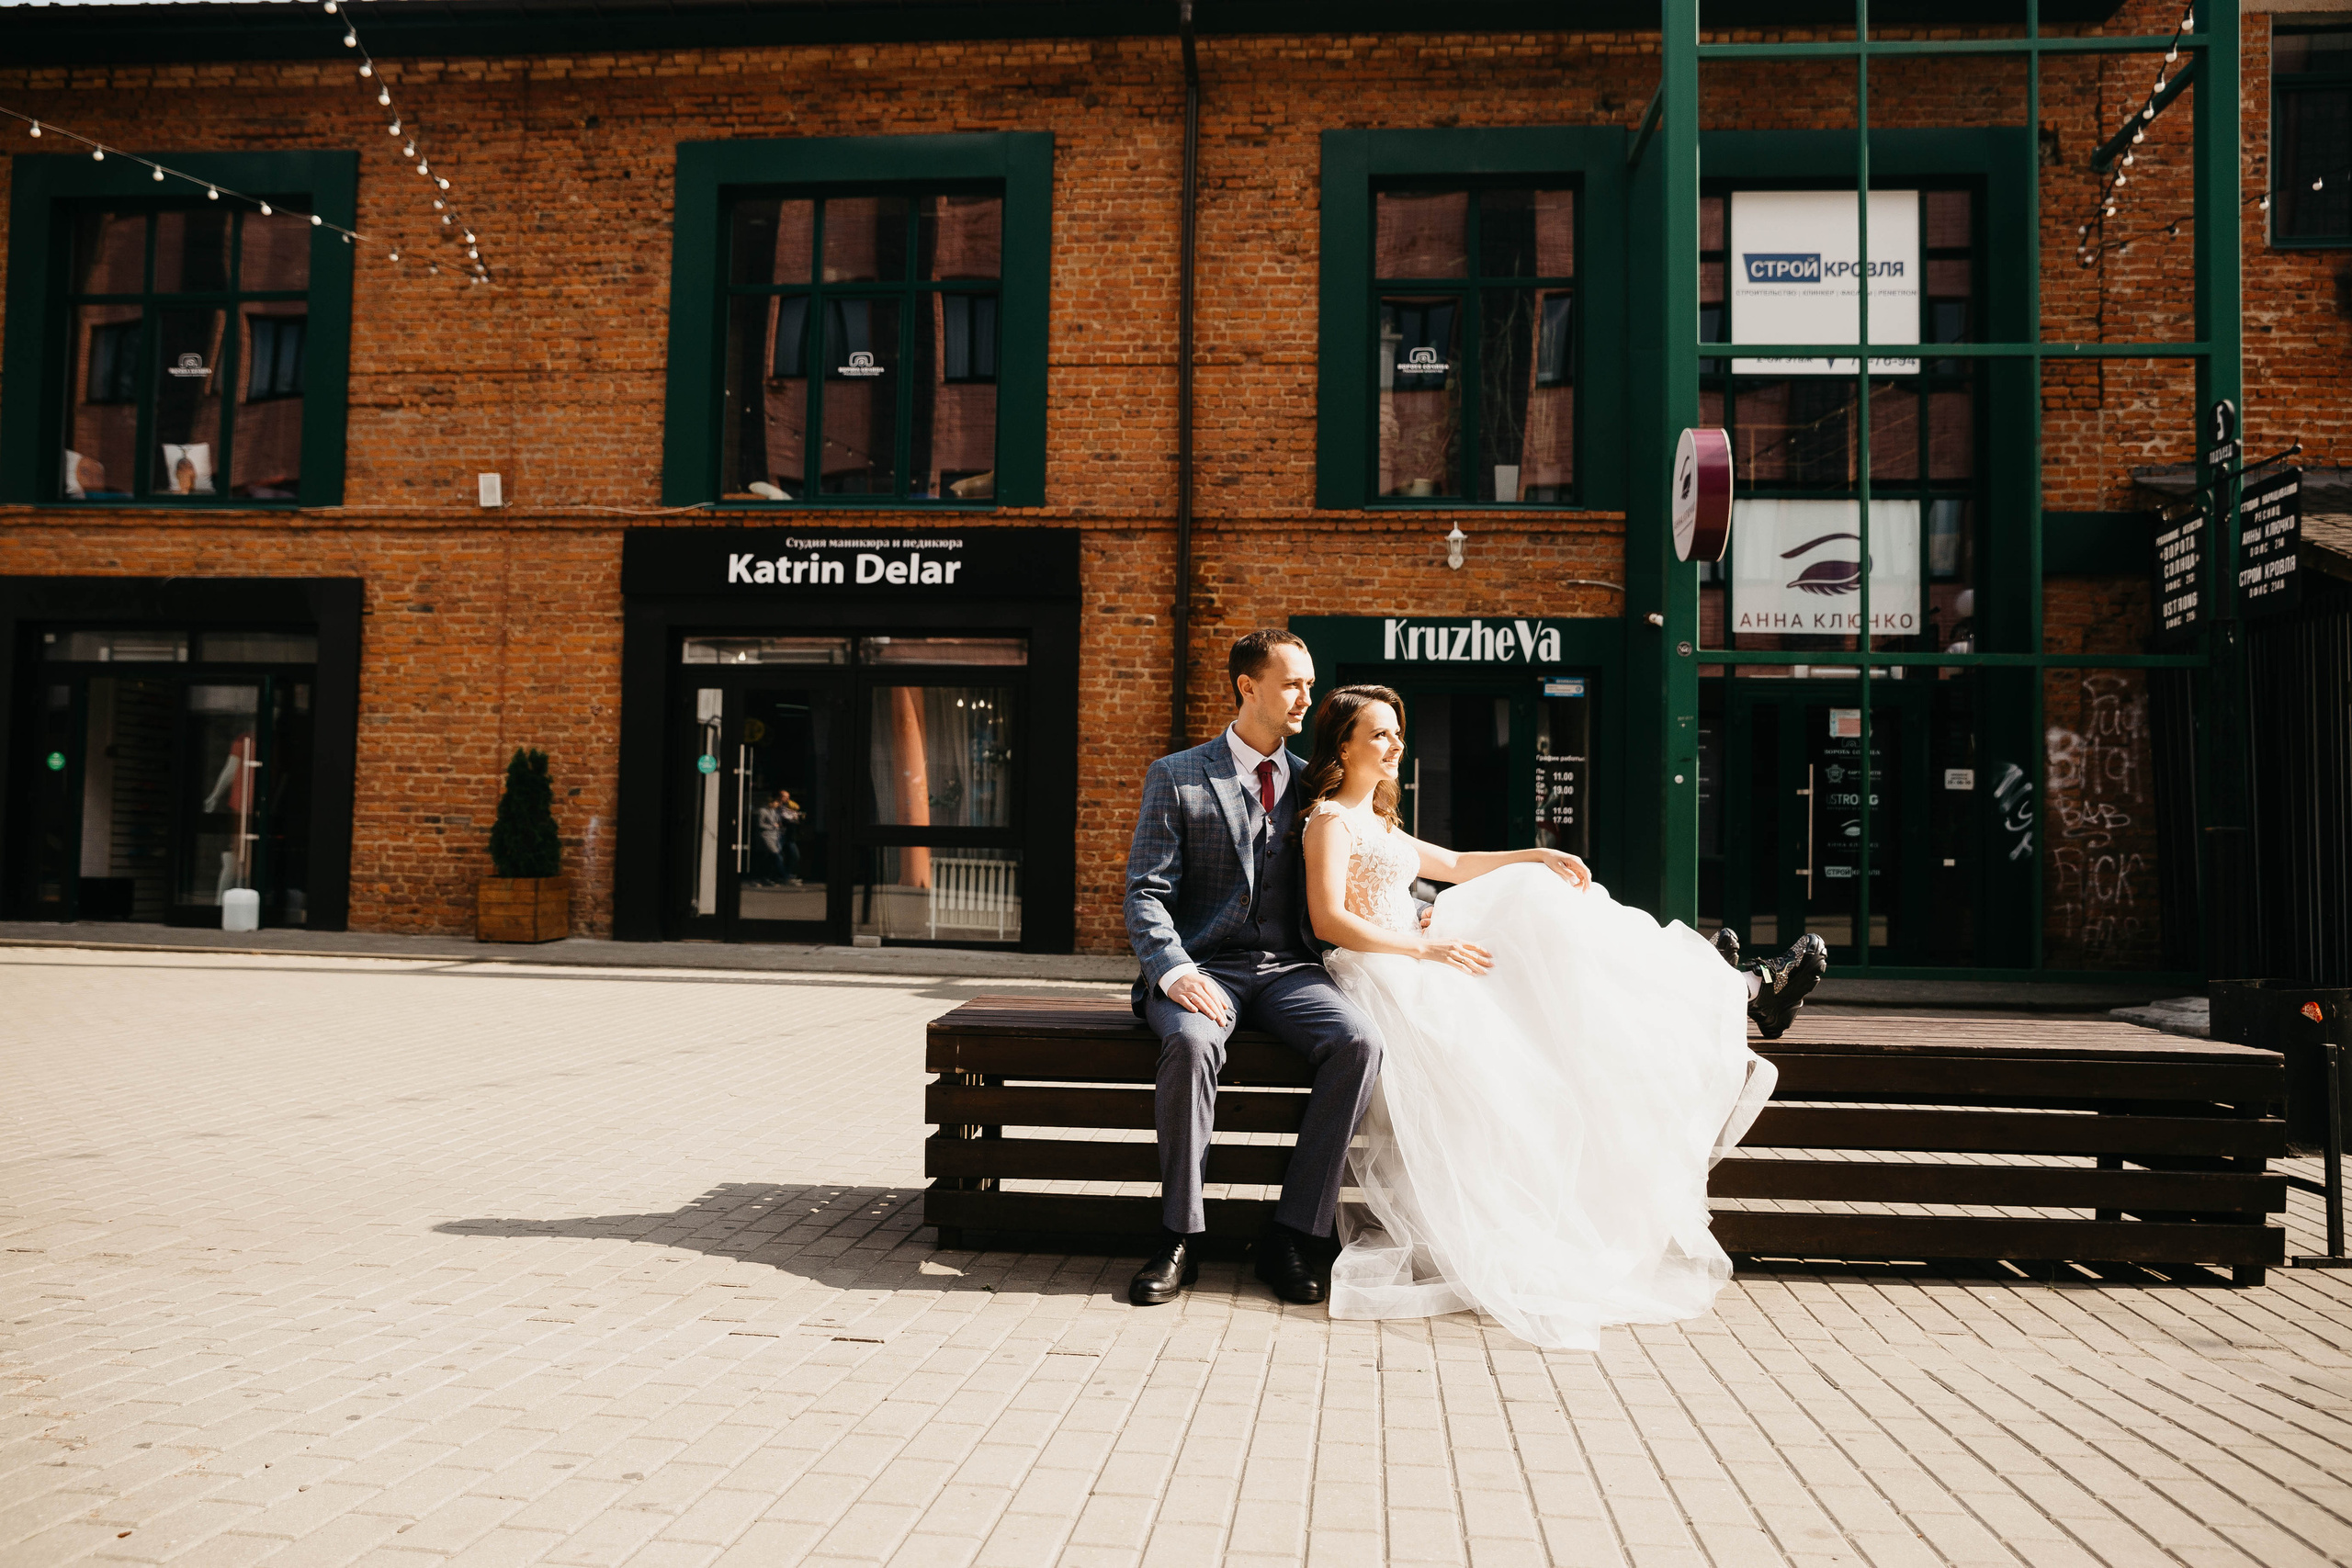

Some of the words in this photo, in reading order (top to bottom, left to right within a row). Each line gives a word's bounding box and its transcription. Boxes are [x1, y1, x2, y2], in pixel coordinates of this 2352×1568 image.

[1749, 256, 1818, 278] СТРОЙ
[786, 536, 827, 550] Студия
[829, 538, 889, 550] маникюра
[892, 540, 900, 548] и
[902, 538, 964, 550] педикюра
[728, 553, 844, 584] Katrin
[855, 553, 962, 584] Delar
[2238, 561, 2262, 588] СТРОЙ
[2264, 554, 2297, 580] КРОВЛЯ
[1740, 612, 1804, 628] АННА
[1384, 618, 1562, 663] KruzheVa
